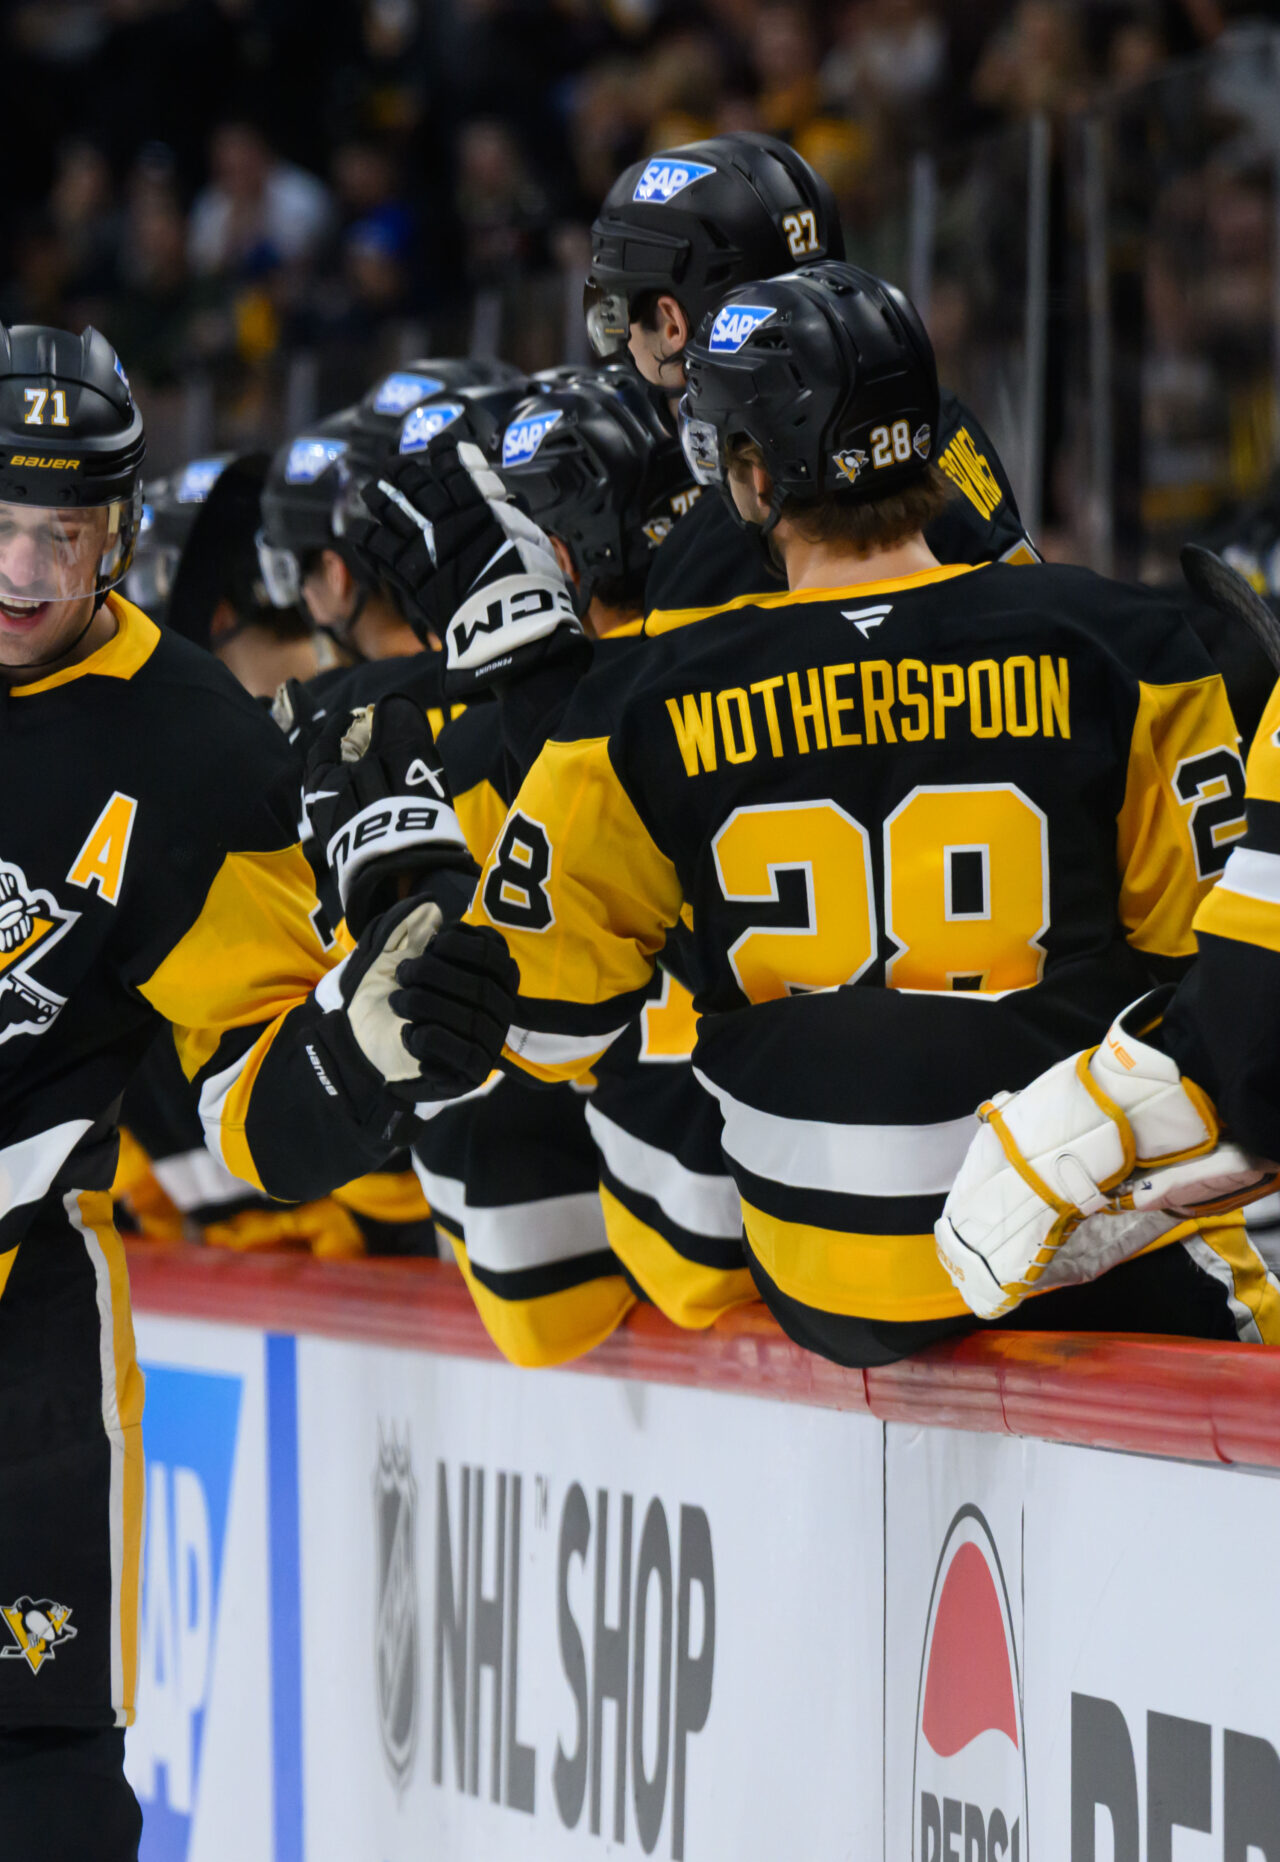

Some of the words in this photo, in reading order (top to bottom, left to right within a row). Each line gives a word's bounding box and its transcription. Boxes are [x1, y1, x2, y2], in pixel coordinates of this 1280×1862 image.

[639, 165, 689, 197] SAP
[782, 209, 820, 257] 27
[712, 312, 754, 343] SAP
[24, 387, 70, 427] 71
[10, 454, 81, 470] BAUER
[505, 424, 542, 458] SAP
[870, 419, 912, 470] 28
[475, 656, 513, 678] PENGUINS
[665, 655, 1071, 777] WOTHERSPOON
[1171, 744, 1247, 882] 2
[66, 790, 139, 907] A
[477, 808, 557, 934] 8
[711, 783, 1051, 1003] 28
[305, 1044, 338, 1096] BAUER
[132, 1460, 213, 1816] AP
[431, 1460, 537, 1817] NHL
[552, 1480, 717, 1862] SHOP
